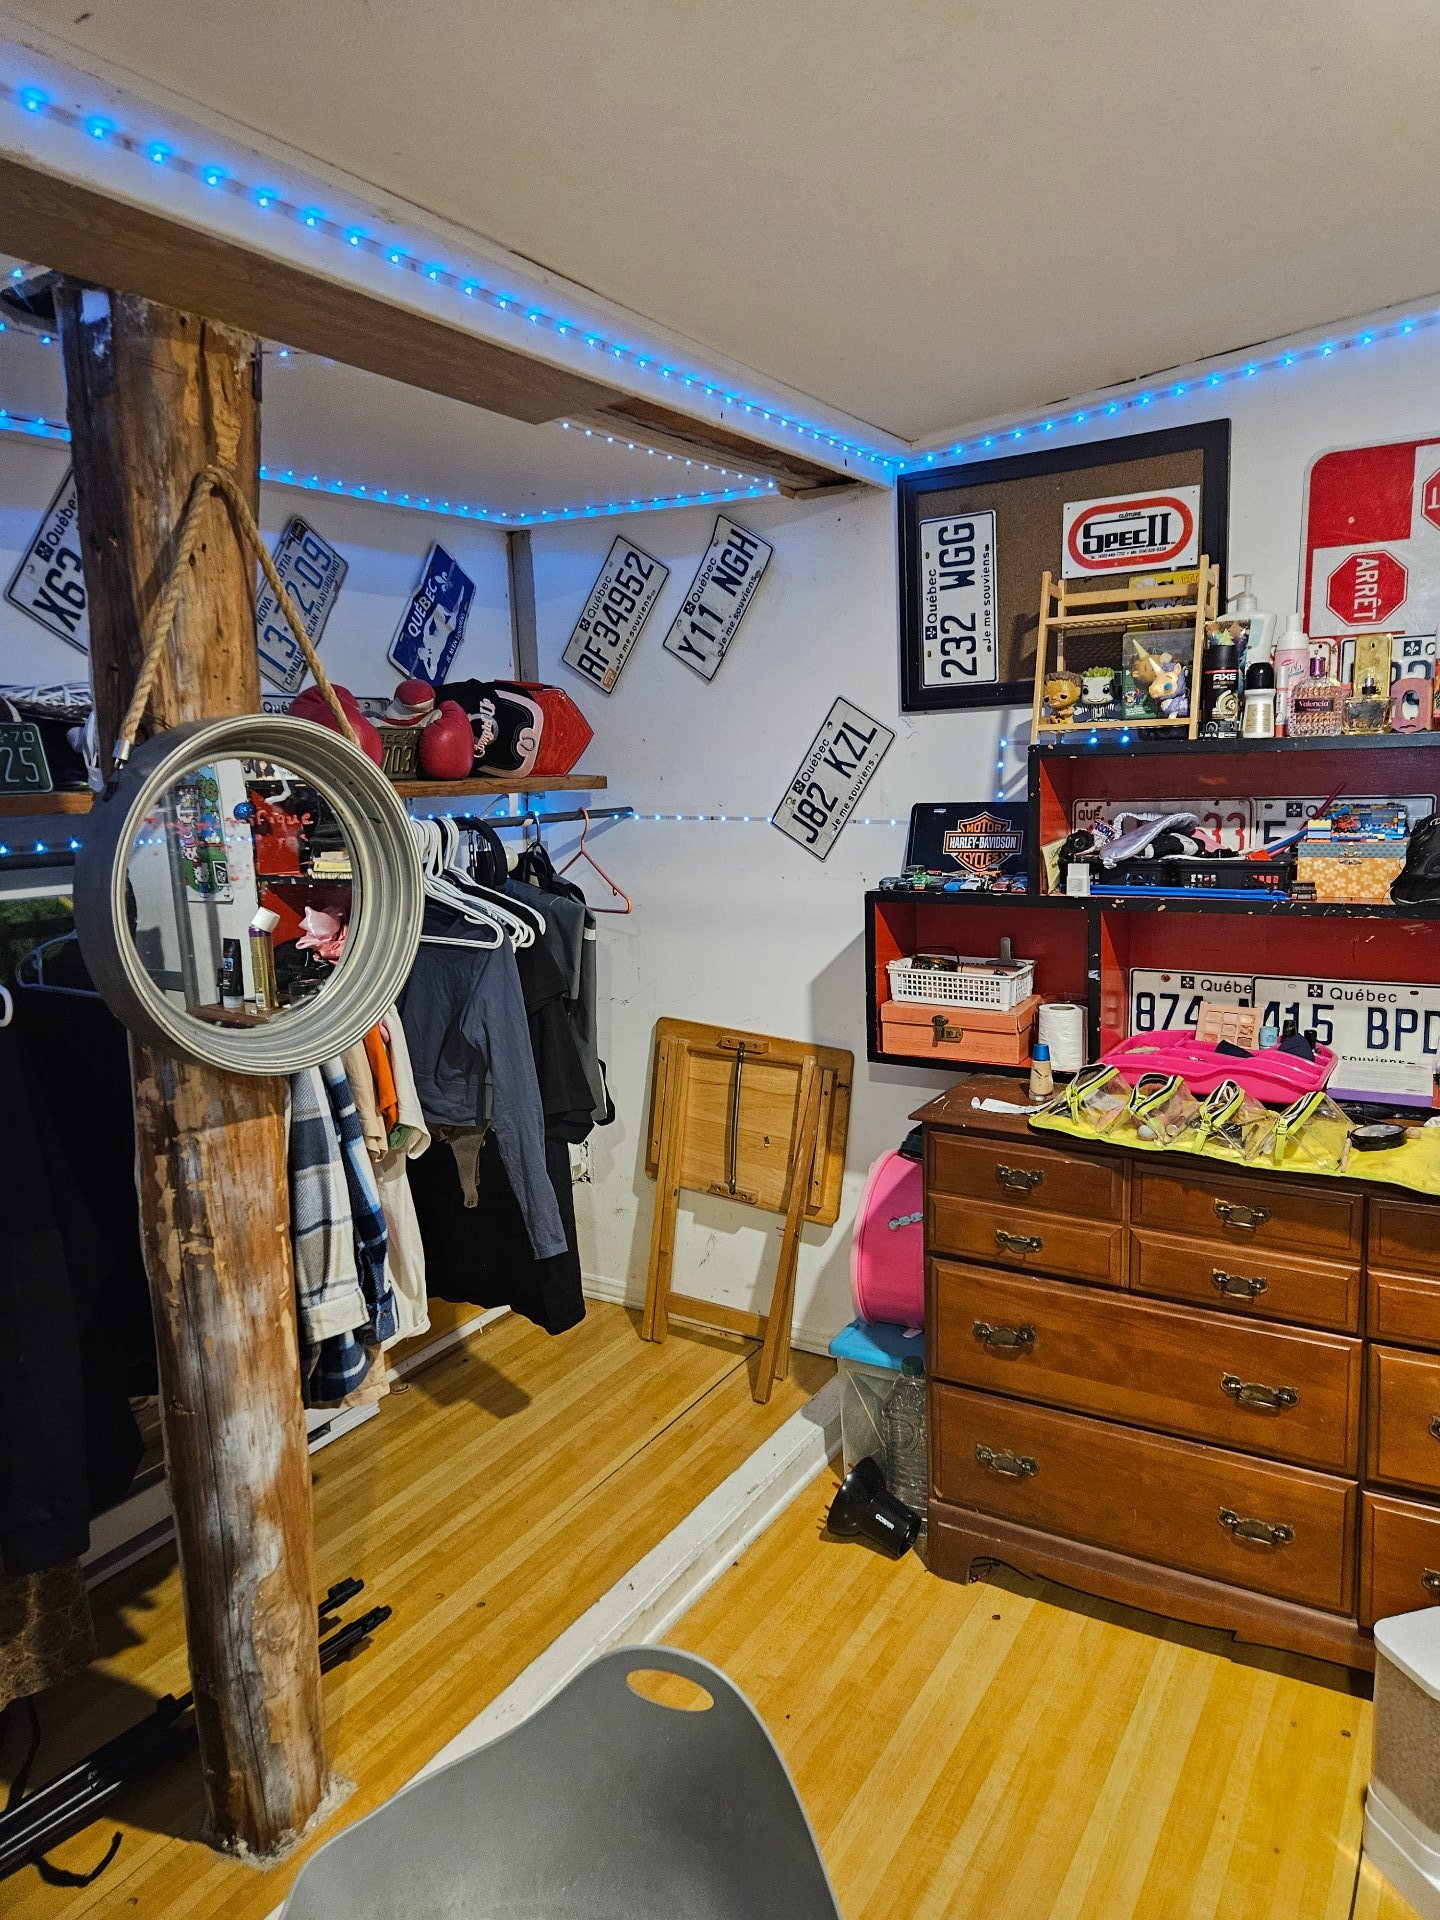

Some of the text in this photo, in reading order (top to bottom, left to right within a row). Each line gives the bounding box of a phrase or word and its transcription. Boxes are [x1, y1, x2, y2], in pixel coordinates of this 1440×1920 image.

[46, 491, 77, 546] Québe
[408, 578, 438, 638] QUÉBEC
[587, 575, 611, 619] Québec
[678, 528, 759, 662] Y11 NGH
[691, 557, 717, 603] Québec
[926, 568, 938, 624] Québec
[938, 522, 977, 678] 232 WGG
[981, 552, 992, 644] Je me souviens
[1353, 558, 1382, 620] ARRÊT
[577, 551, 654, 682] AF34952
[615, 595, 652, 664] Je me souviens
[718, 576, 757, 649] Je me souviens
[1213, 673, 1237, 681] AXE
[792, 721, 878, 843] J82 KZL
[801, 738, 830, 782] Québec
[831, 759, 875, 830] Je me souviens
[949, 836, 1017, 849] HARLEY-DAVIDSON
[966, 819, 1001, 832] MOTOR
[963, 852, 999, 868] CYCLES
[1200, 979, 1252, 994] Québe
[1329, 987, 1397, 1002] Québec
